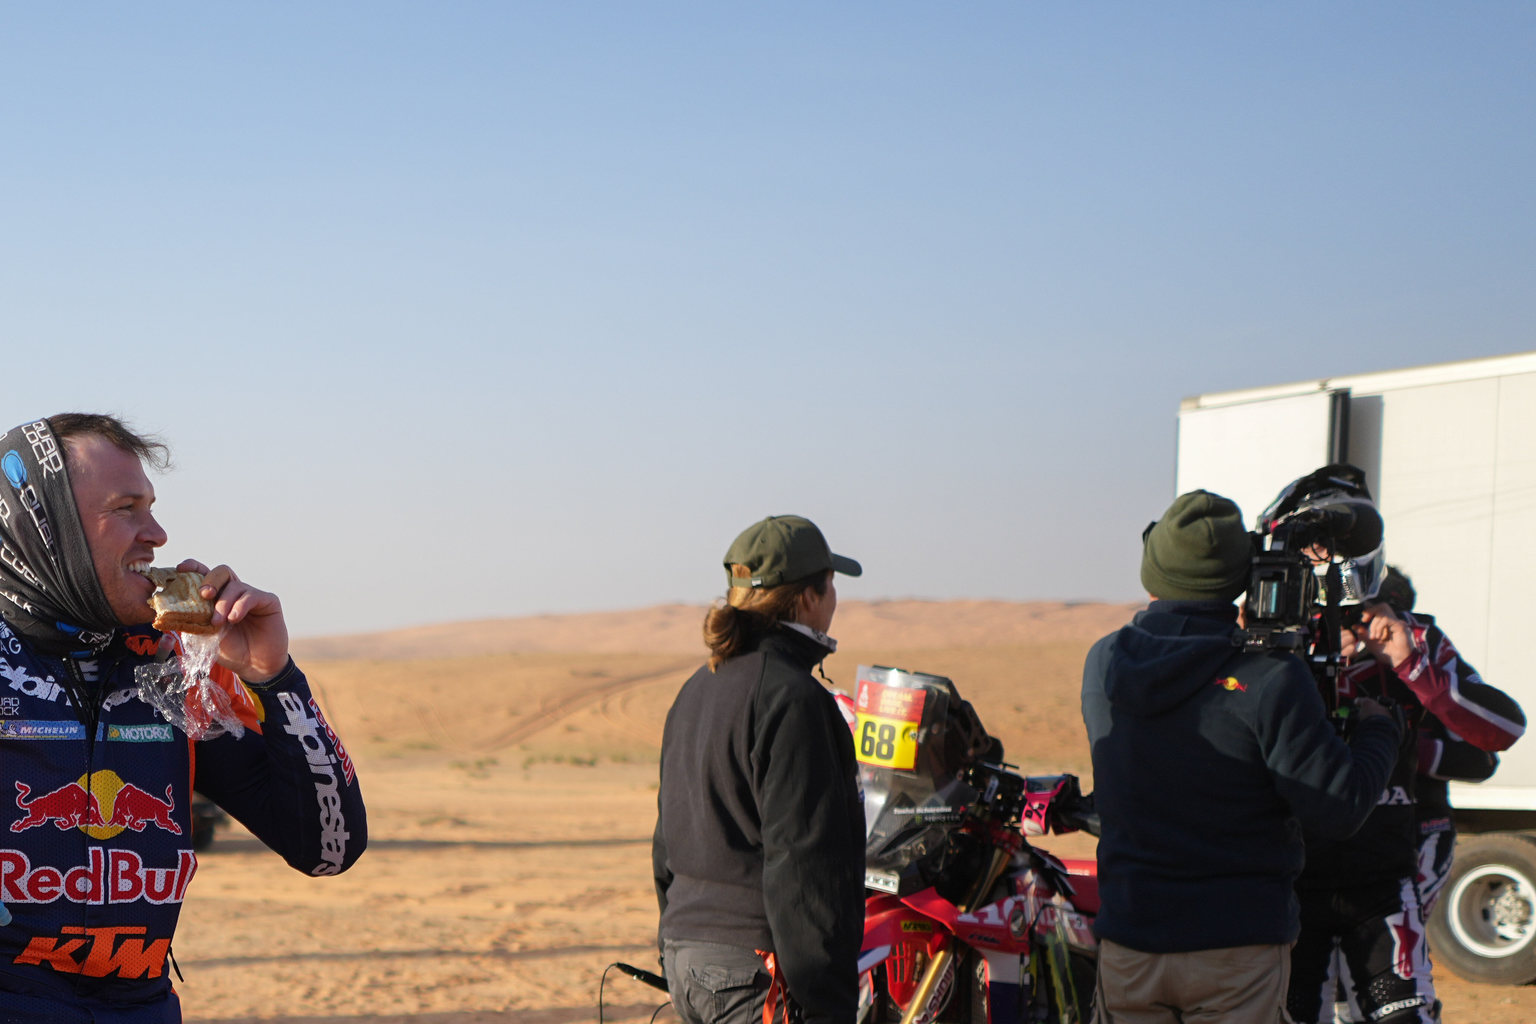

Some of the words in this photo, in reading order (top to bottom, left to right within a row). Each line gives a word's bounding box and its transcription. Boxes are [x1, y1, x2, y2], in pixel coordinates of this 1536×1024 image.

[22, 424, 53, 479] LOCK
[32, 420, 63, 473] QUAD
[19, 725, 79, 735] MICHELIN
[119, 727, 171, 741] MOTOREX
[861, 721, 896, 760] 68
[277, 692, 350, 877] alpinestars
[13, 926, 171, 979] KTM
